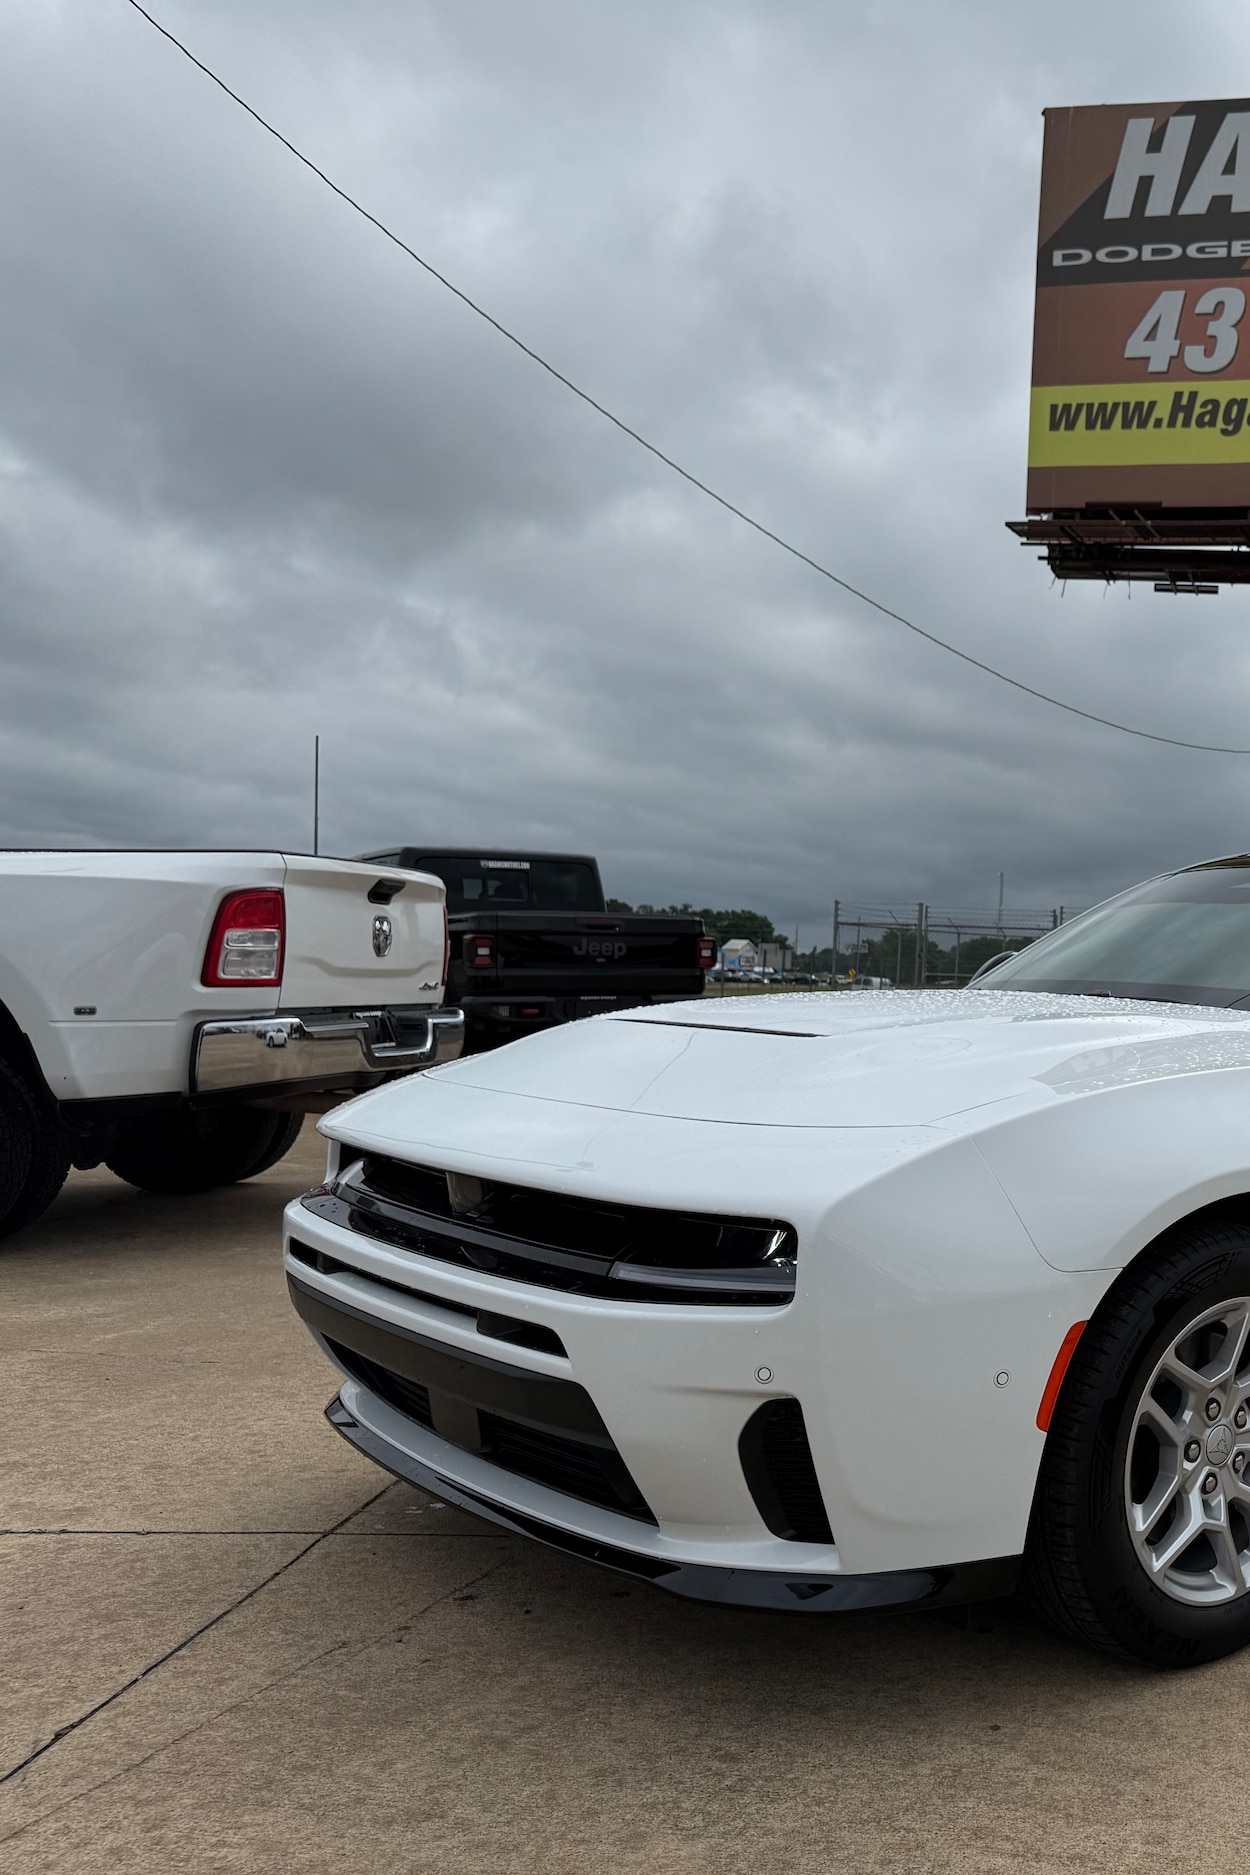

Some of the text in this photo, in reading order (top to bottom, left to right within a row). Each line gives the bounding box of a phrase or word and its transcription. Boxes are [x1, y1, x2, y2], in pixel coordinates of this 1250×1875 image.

[1123, 286, 1247, 374] 43
[573, 938, 627, 959] Jeep
[1115, 1327, 1144, 1379] OUTSIDE
